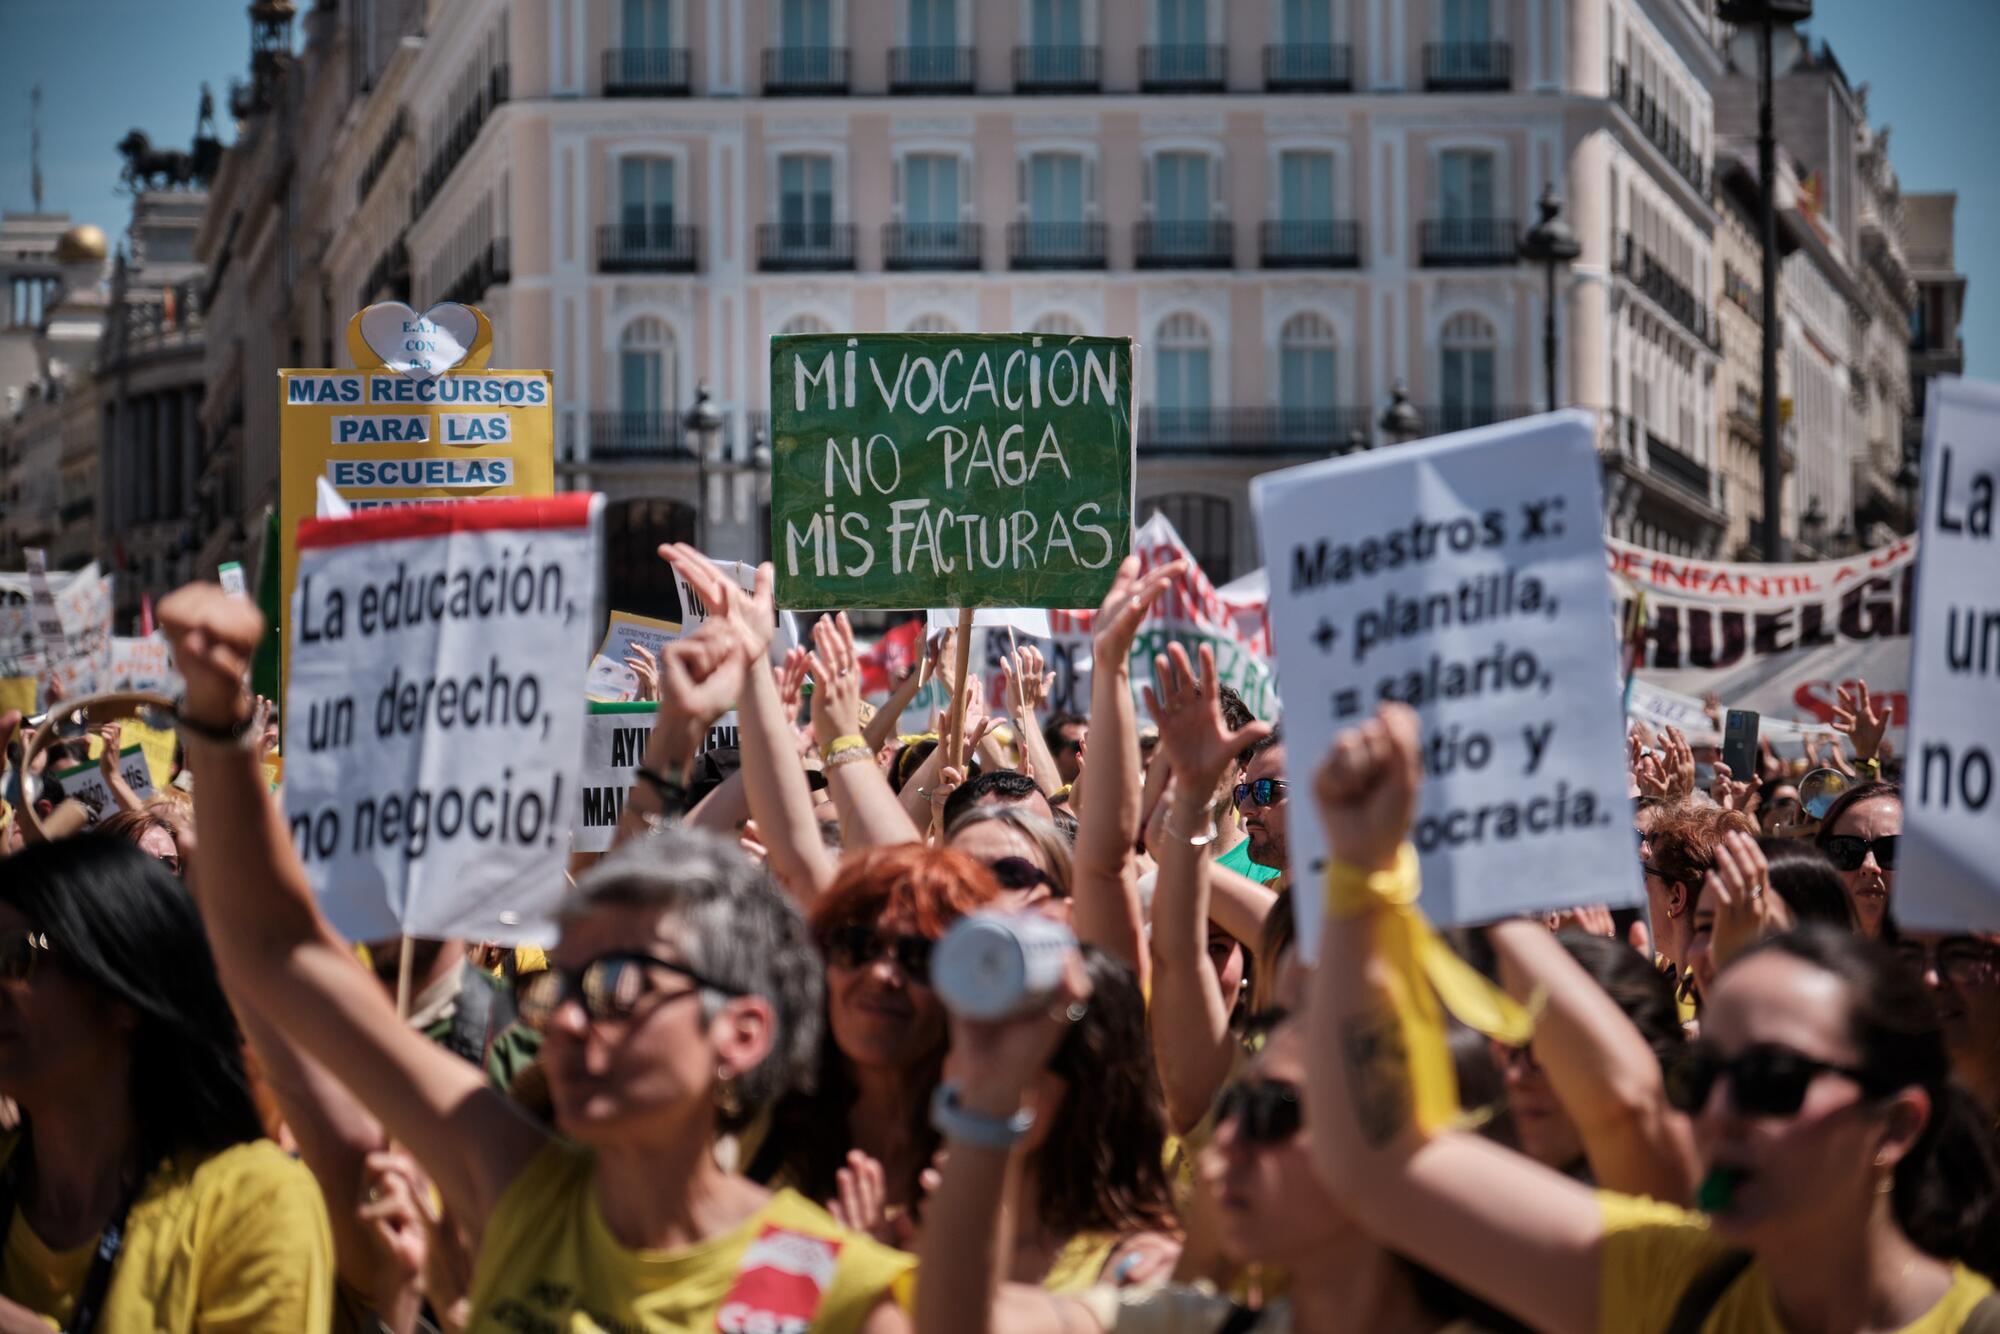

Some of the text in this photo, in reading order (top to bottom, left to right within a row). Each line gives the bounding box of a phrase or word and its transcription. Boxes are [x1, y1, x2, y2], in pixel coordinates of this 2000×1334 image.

[405, 340, 436, 351] CON
[289, 379, 546, 403] MAS RECURSOS
[339, 418, 507, 442] PARA LAS
[825, 422, 1071, 497] NO PAGA
[335, 461, 507, 485] ESCUELAS
[1937, 446, 1995, 540] La
[886, 499, 1113, 577] FACTURAS
[1290, 508, 1505, 595] Maestros
[301, 543, 576, 643] La educación,
[1354, 567, 1558, 663] plantilla,
[1652, 559, 1822, 600] INFANTIL
[308, 656, 552, 754] un derecho,
[1375, 643, 1553, 705] salario,
[1522, 722, 1554, 775] y
[1919, 741, 1993, 812] no
[289, 769, 564, 862] no negocio!
